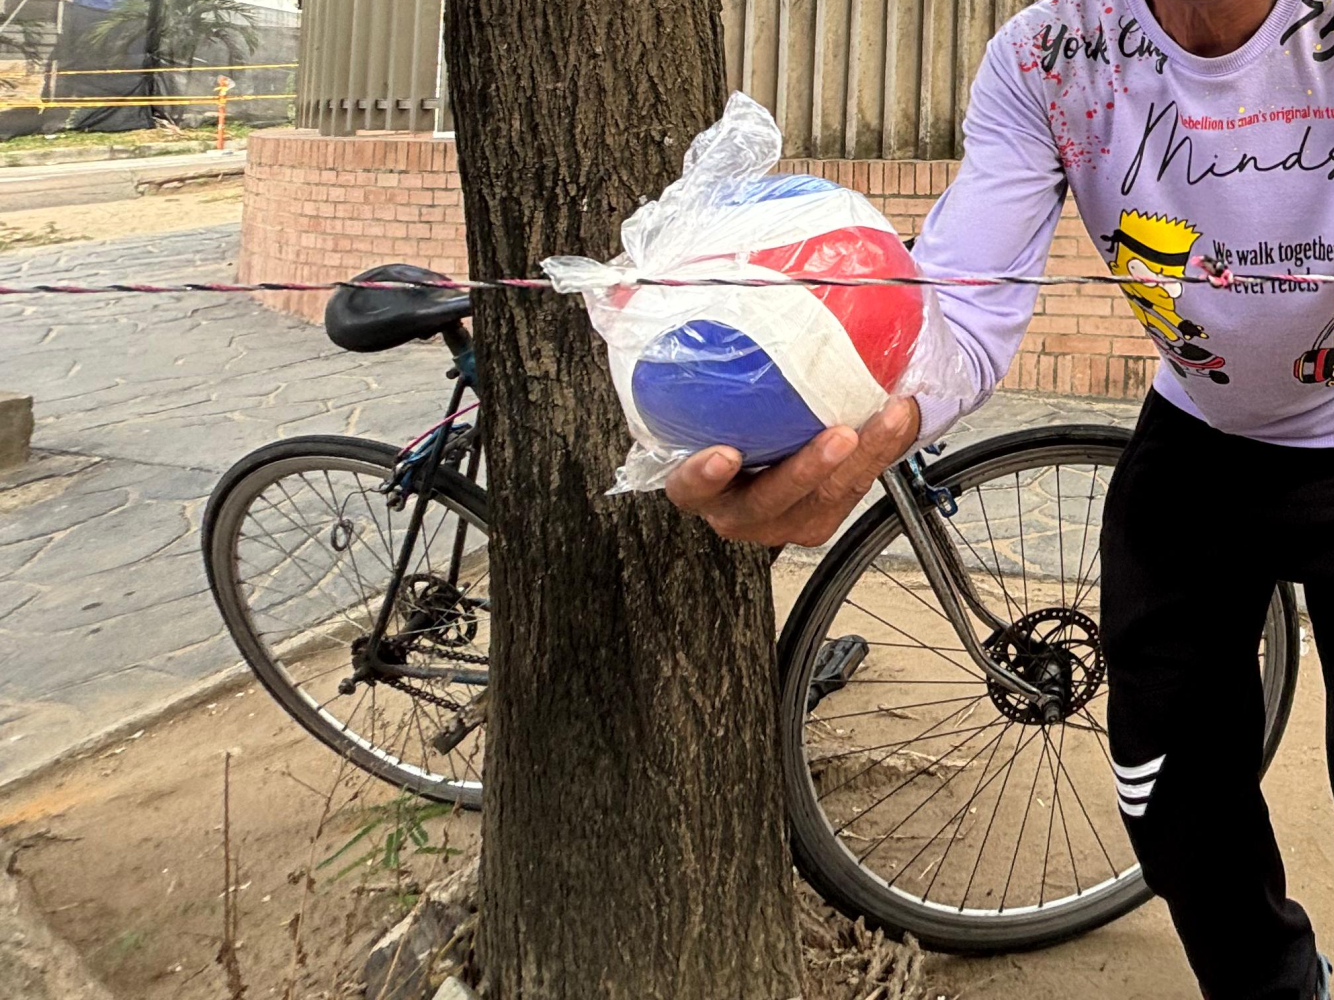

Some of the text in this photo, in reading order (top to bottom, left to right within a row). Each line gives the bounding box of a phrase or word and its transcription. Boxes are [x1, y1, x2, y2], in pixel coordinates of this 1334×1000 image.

[1226, 117, 1236, 130] is
[1238, 110, 1268, 128] man's
[1269, 106, 1311, 124] original
[1236, 241, 1276, 267] walk
